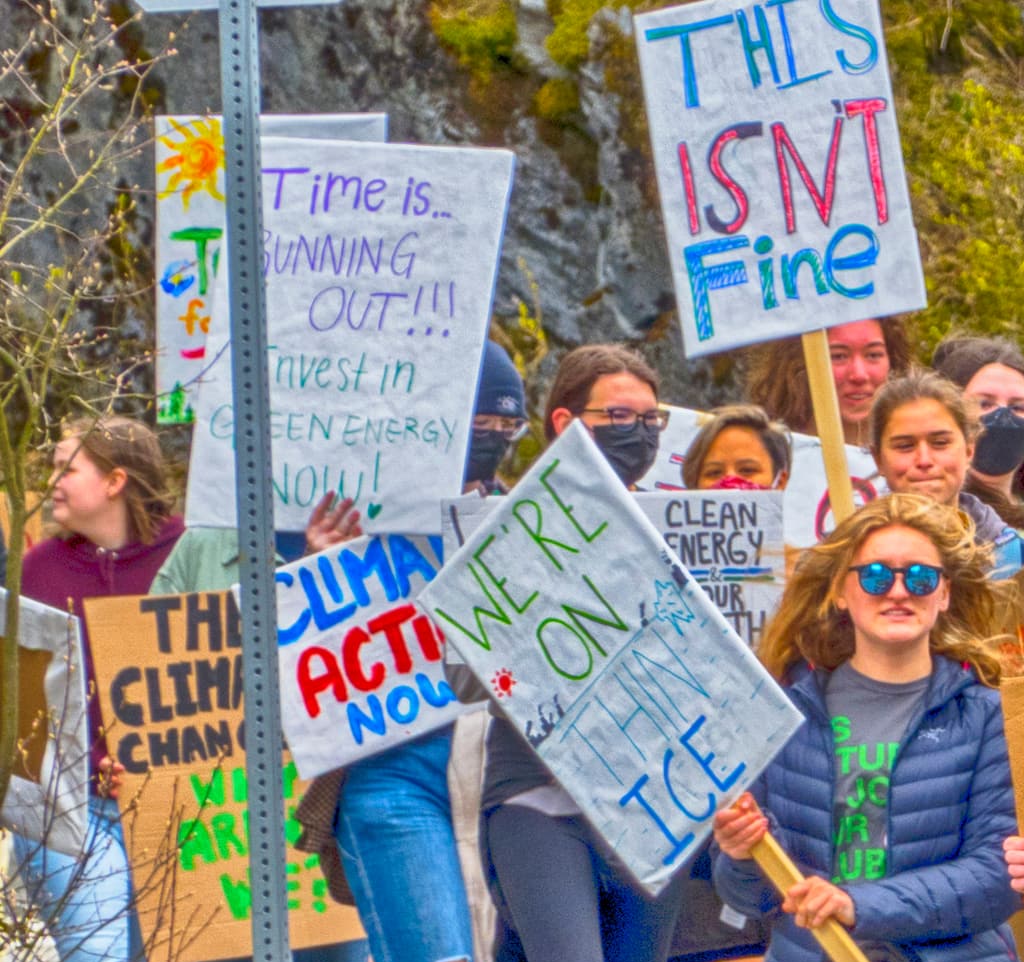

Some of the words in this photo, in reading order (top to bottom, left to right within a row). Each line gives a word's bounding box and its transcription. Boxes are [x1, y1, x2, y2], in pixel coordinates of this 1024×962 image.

[645, 0, 879, 109] THIS
[262, 168, 387, 213] Time
[677, 97, 889, 235] ISN'T
[309, 281, 456, 337] OUT!!!
[683, 223, 881, 342] Fine
[381, 353, 416, 394] in
[209, 404, 330, 450] GEEN
[344, 414, 457, 447] ENERGY
[435, 458, 608, 651] WE'RE
[664, 531, 763, 566] ENERGY
[665, 499, 758, 530] CLEAN
[275, 534, 443, 645] CLIMA
[536, 575, 629, 681] ON
[110, 656, 244, 727] CLIM
[296, 604, 446, 718] ACTI
[559, 627, 712, 786] THIN
[117, 721, 266, 774] CHAN
[619, 715, 746, 866] ICE
